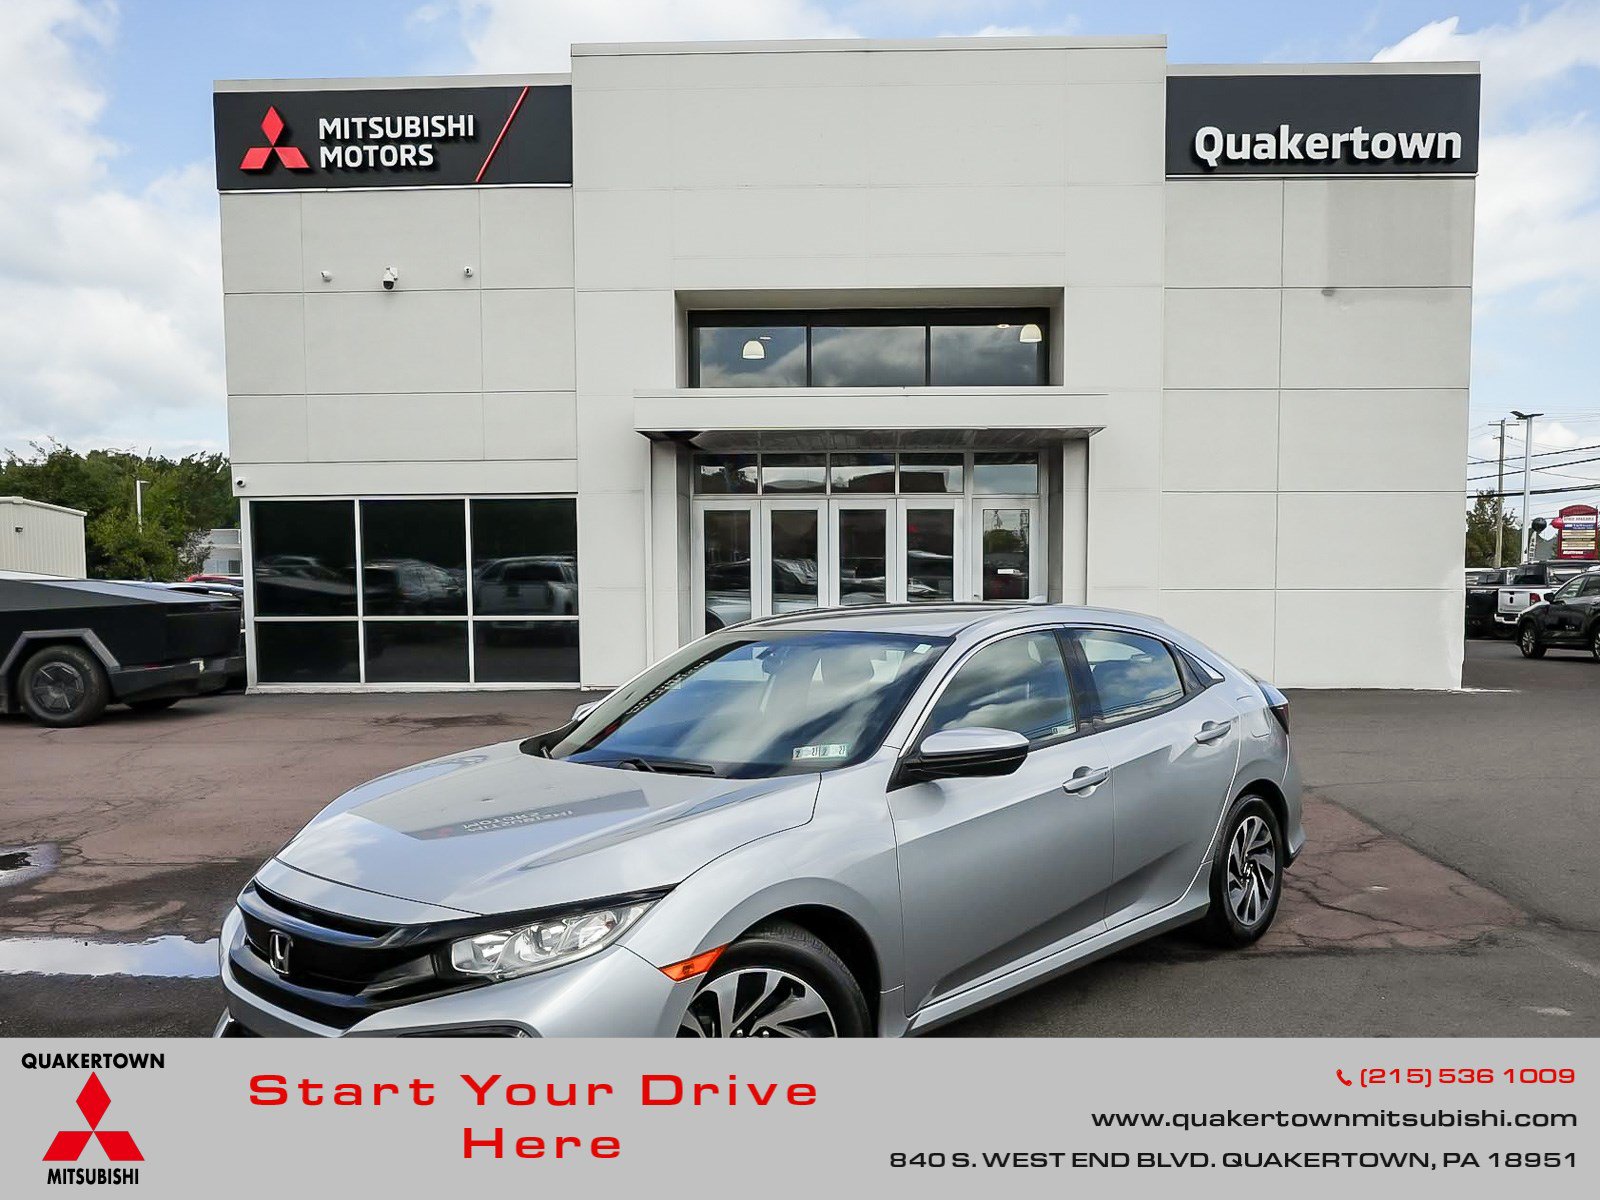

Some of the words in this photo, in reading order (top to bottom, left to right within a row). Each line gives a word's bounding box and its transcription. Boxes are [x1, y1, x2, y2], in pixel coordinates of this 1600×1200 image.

[319, 114, 475, 139] MITSUBISHI
[320, 144, 434, 168] MOTORS
[1194, 124, 1463, 167] Quakertown
